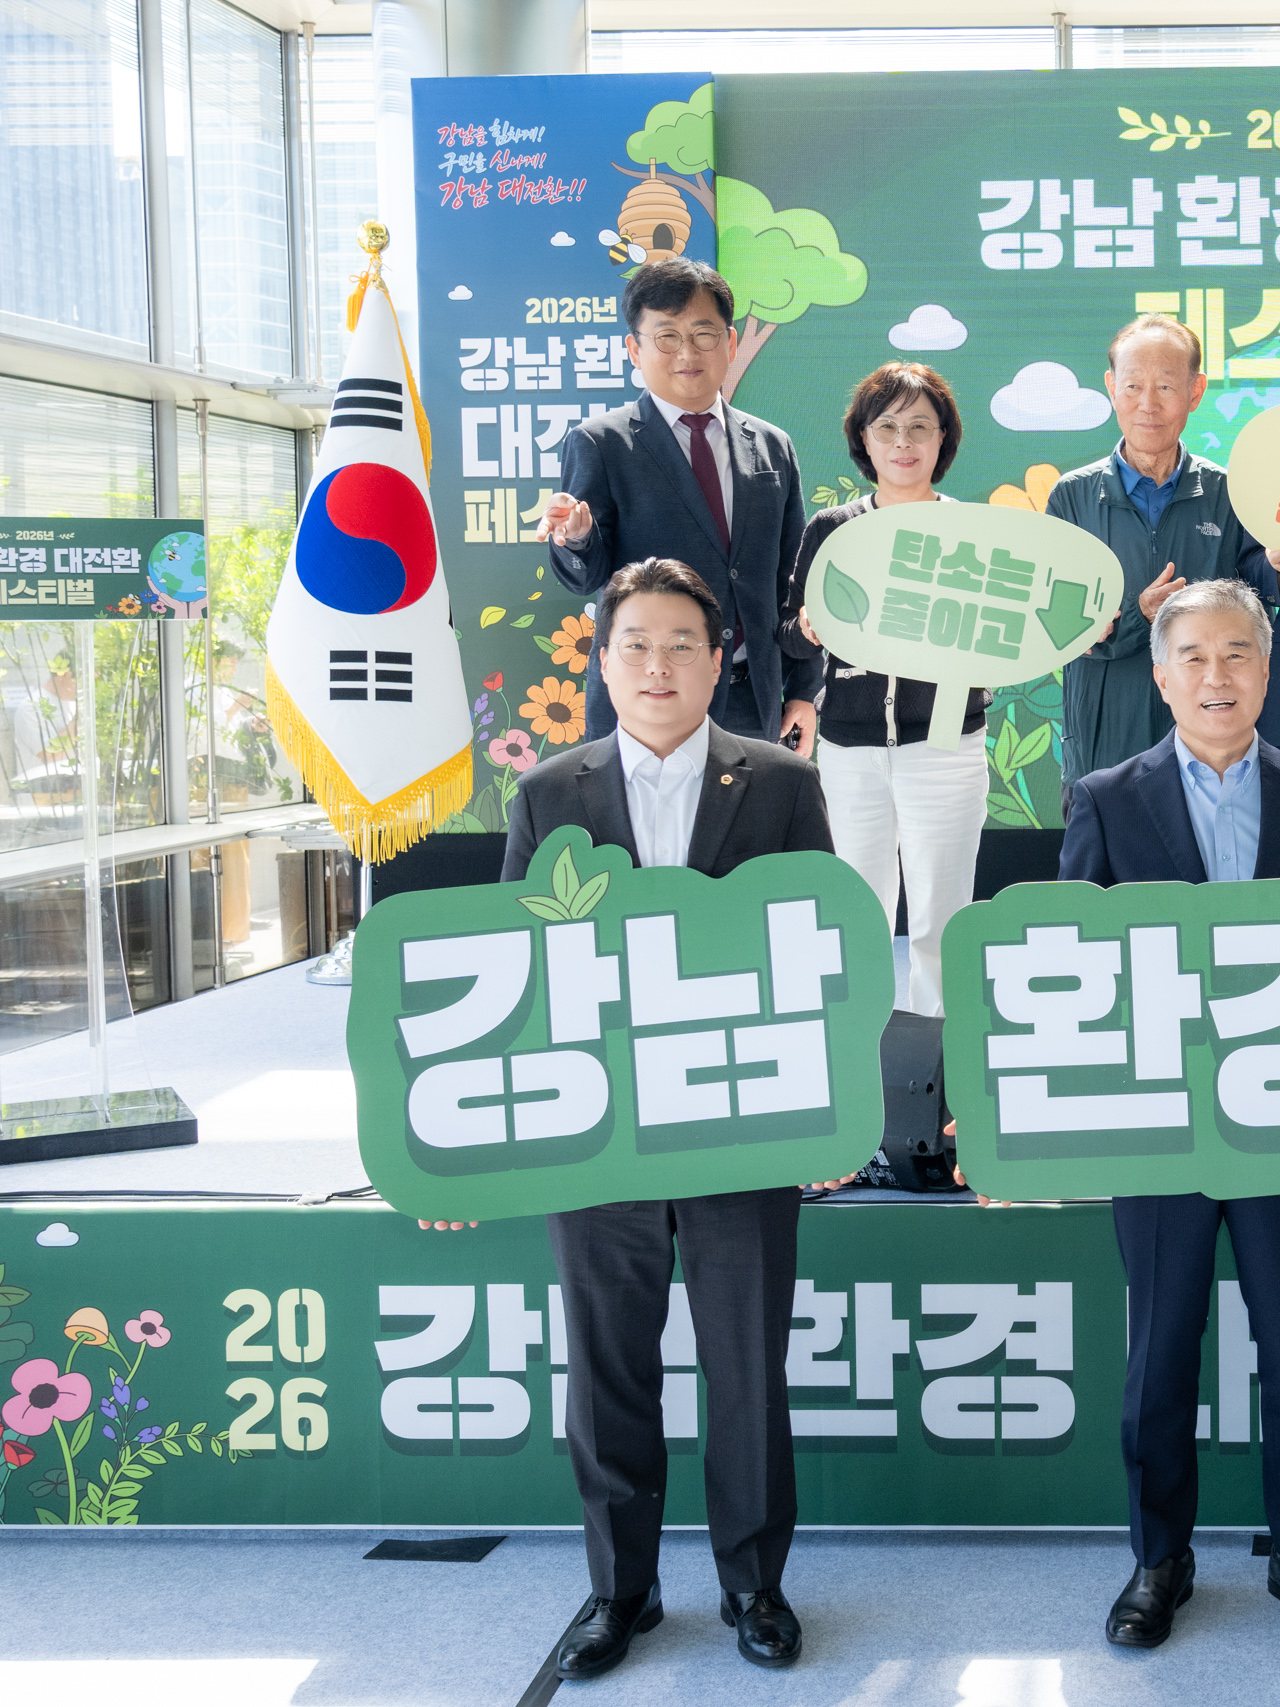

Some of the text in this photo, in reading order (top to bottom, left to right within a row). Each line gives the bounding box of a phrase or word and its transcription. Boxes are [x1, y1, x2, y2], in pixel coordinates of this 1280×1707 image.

[437, 117, 546, 147] 강남을 힘차게!
[438, 148, 547, 177] 구민을 신나게!
[438, 174, 588, 210] 강남 대전환!!
[978, 178, 1163, 270] 강남
[525, 296, 618, 324] 2026년
[459, 334, 648, 391] 강남 환
[16, 531, 54, 540] 2026년
[54, 548, 141, 573] 대전환
[889, 529, 1036, 602] 탄소는
[0, 579, 95, 605] 스티벌
[878, 587, 1026, 660] 줄이고
[399, 899, 843, 1148] 강남
[222, 1288, 326, 1363] 20
[225, 1377, 329, 1452] 26
